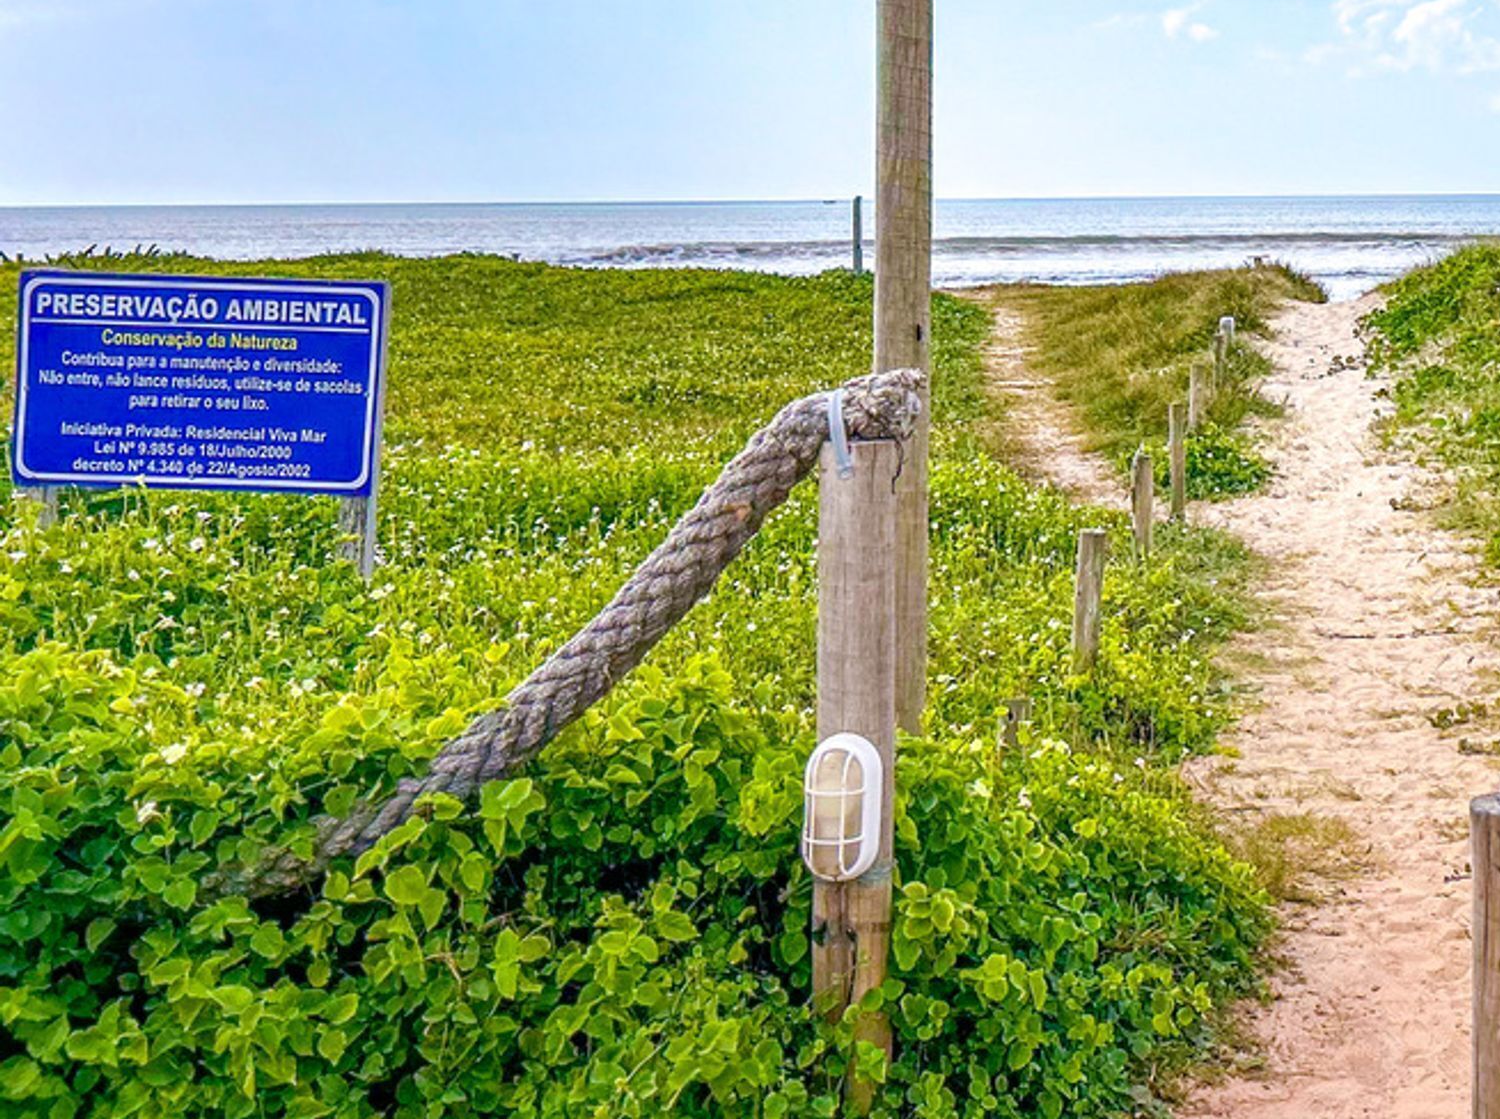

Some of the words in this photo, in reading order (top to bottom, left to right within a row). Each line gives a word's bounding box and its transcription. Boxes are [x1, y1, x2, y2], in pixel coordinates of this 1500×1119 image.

[36, 292, 218, 324] PRESERVAÇÃO
[225, 298, 367, 324] AMBIENTAL
[101, 328, 203, 350] Conservação
[206, 332, 226, 348] da
[230, 332, 298, 350] Natureza
[61, 351, 124, 367] Contribua
[126, 356, 156, 371] para
[159, 357, 167, 368] a
[170, 355, 250, 373] manutenção
[252, 360, 261, 371] e
[264, 357, 342, 373] diversidade:
[39, 369, 64, 385] Não
[67, 372, 103, 388] entre,
[105, 372, 130, 387] não
[133, 372, 168, 388] lance
[234, 376, 292, 392] utilize-se
[295, 378, 310, 392] de
[314, 379, 362, 394] sacolas
[128, 395, 159, 410] para
[161, 393, 200, 408] retirar
[204, 398, 212, 409] o
[216, 398, 239, 410] seu
[242, 395, 269, 411] lixo.
[61, 421, 122, 437] Iniciativa
[126, 424, 182, 439] Privada:
[185, 425, 265, 441] Residencial
[268, 428, 297, 442] Viva
[300, 429, 327, 442] Mar
[94, 441, 116, 454] Lei
[138, 442, 175, 456] 9.985
[177, 443, 195, 456] de
[200, 443, 292, 459] 18/Julho/2000
[72, 457, 125, 472] decreto
[147, 460, 184, 474] 4.340
[186, 461, 204, 475] de
[207, 461, 311, 479] 22/Agosto/2002
